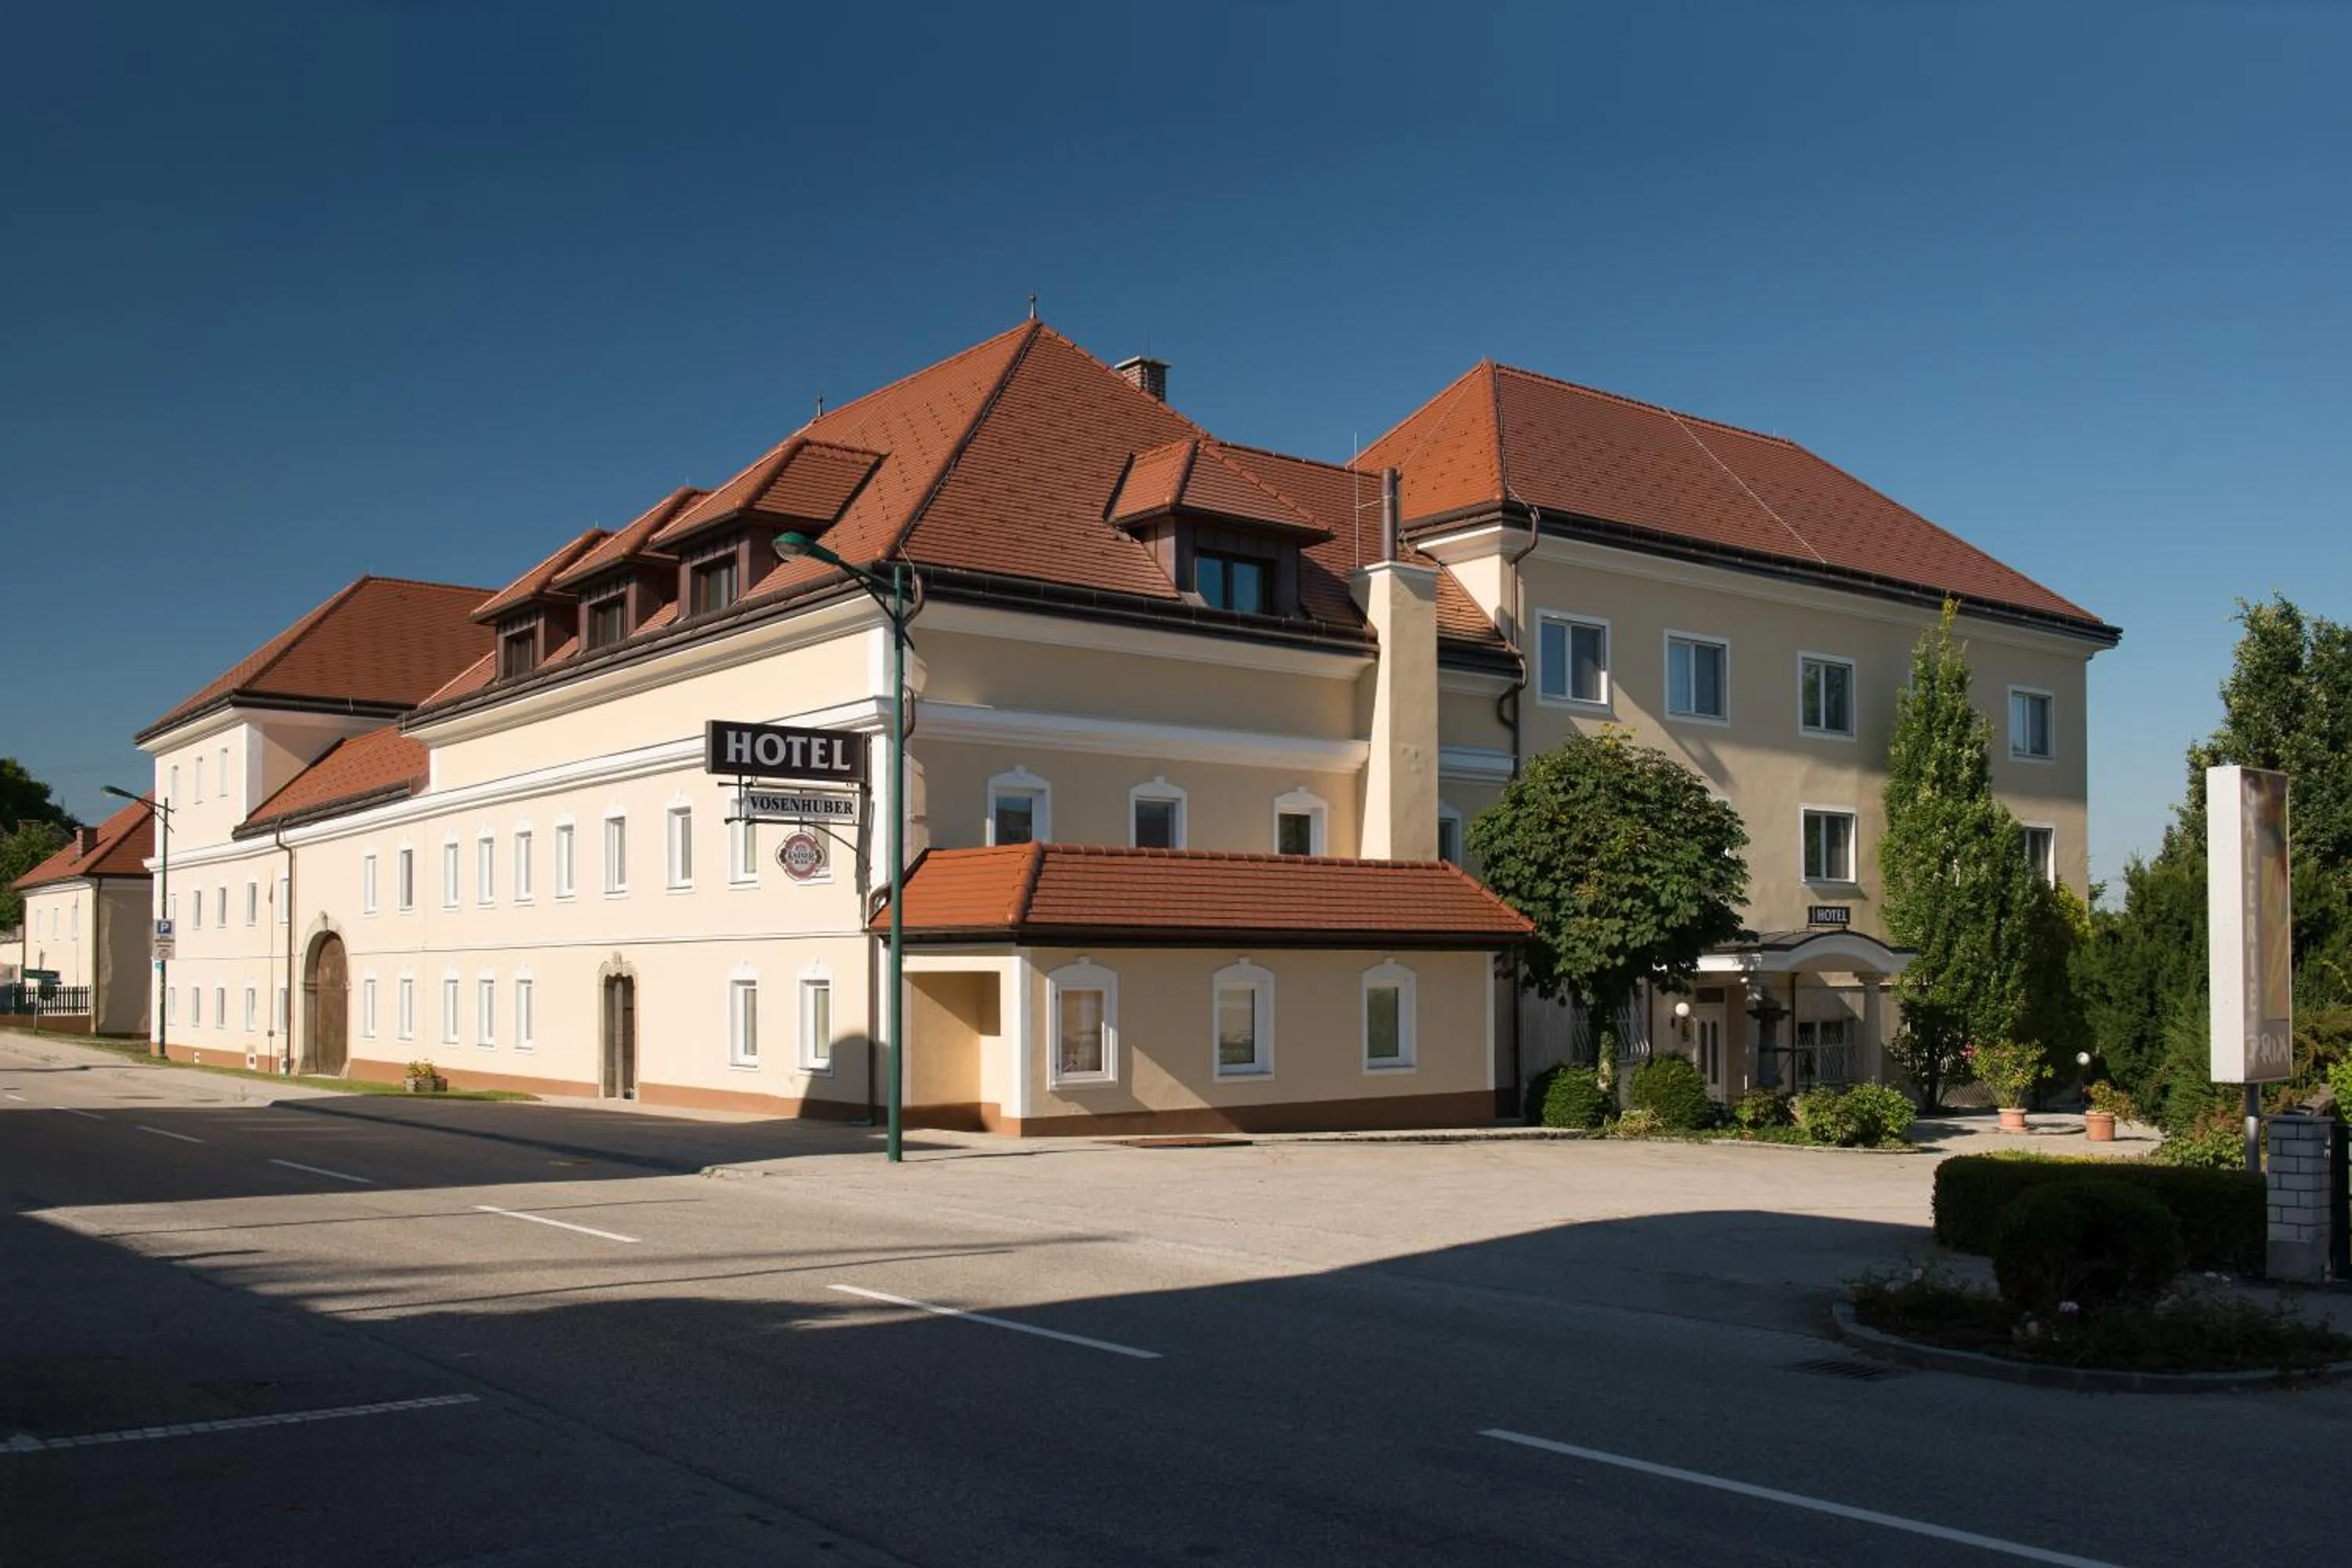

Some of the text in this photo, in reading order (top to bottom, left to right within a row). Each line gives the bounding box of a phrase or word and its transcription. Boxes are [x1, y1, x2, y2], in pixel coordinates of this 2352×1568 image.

[726, 730, 851, 771] HOTEL
[750, 796, 854, 814] VOSENHUBER
[1817, 909, 1848, 922] HOTEL
